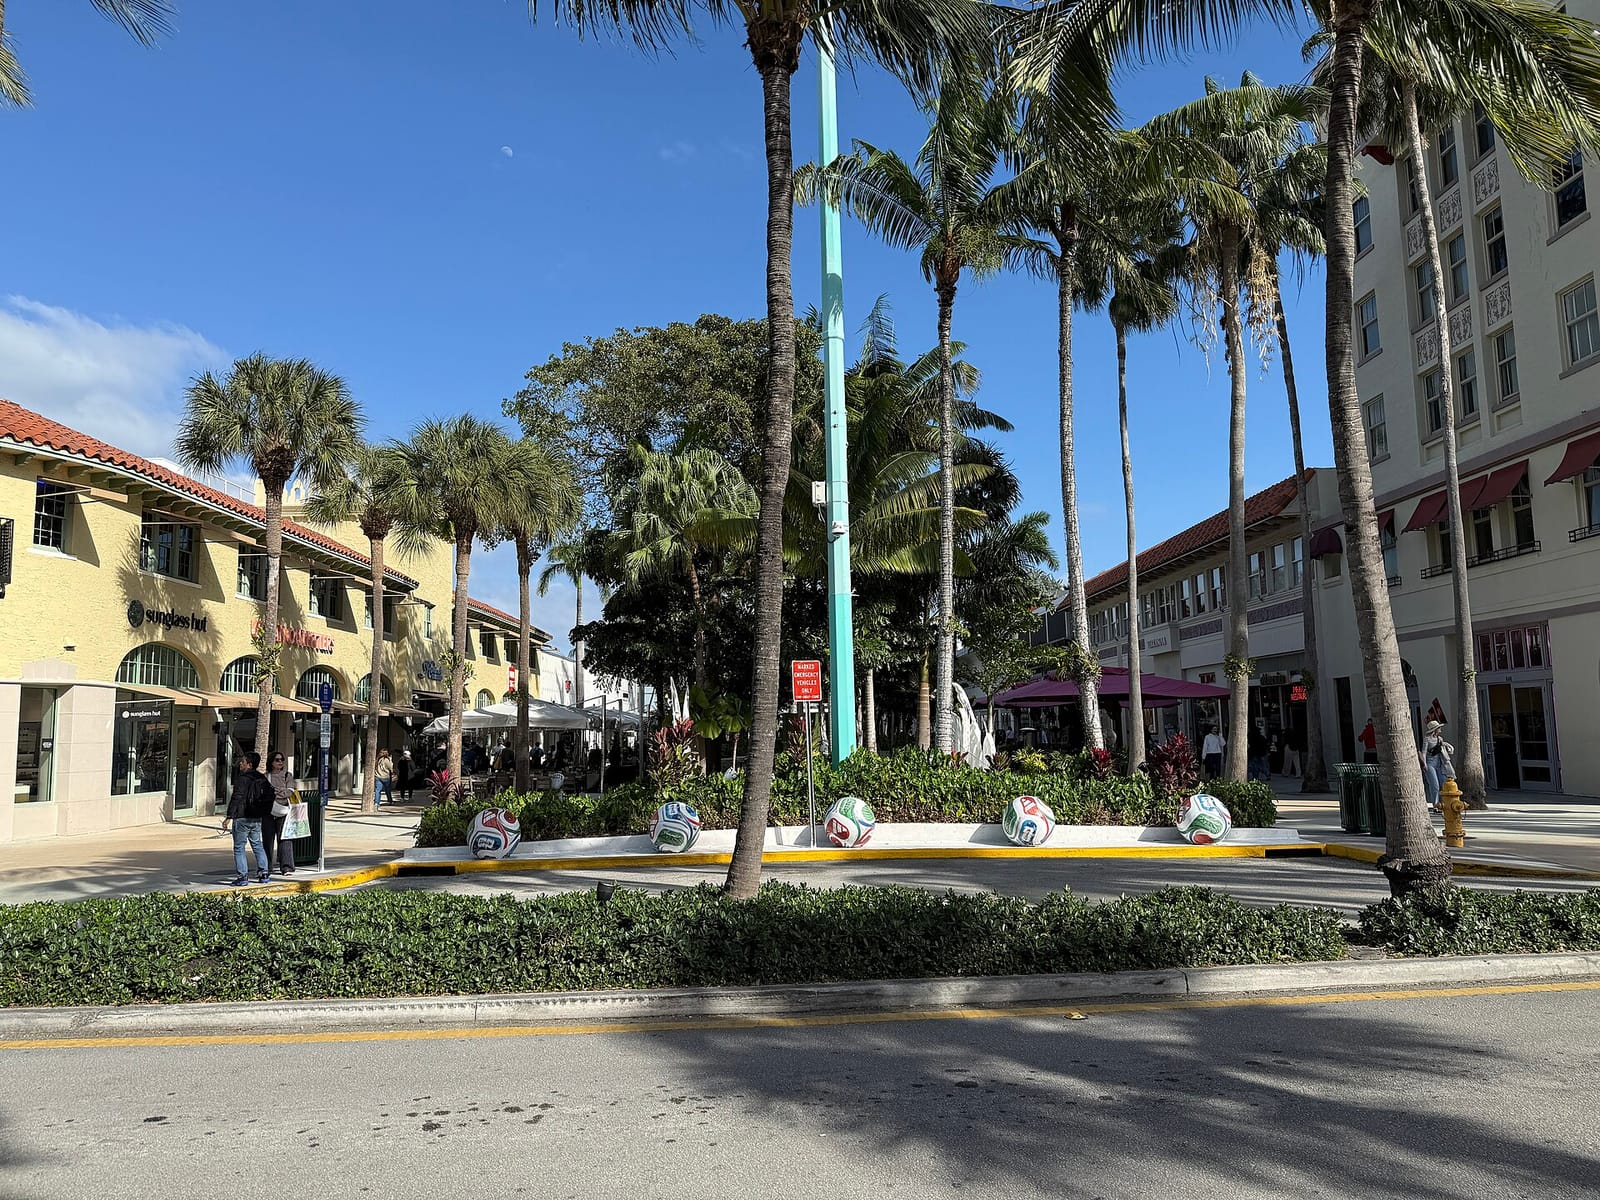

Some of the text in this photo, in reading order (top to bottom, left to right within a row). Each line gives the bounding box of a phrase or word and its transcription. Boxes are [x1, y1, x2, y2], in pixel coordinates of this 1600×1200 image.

[146, 608, 208, 632] sunglass hut
[130, 710, 151, 718] sunglass
